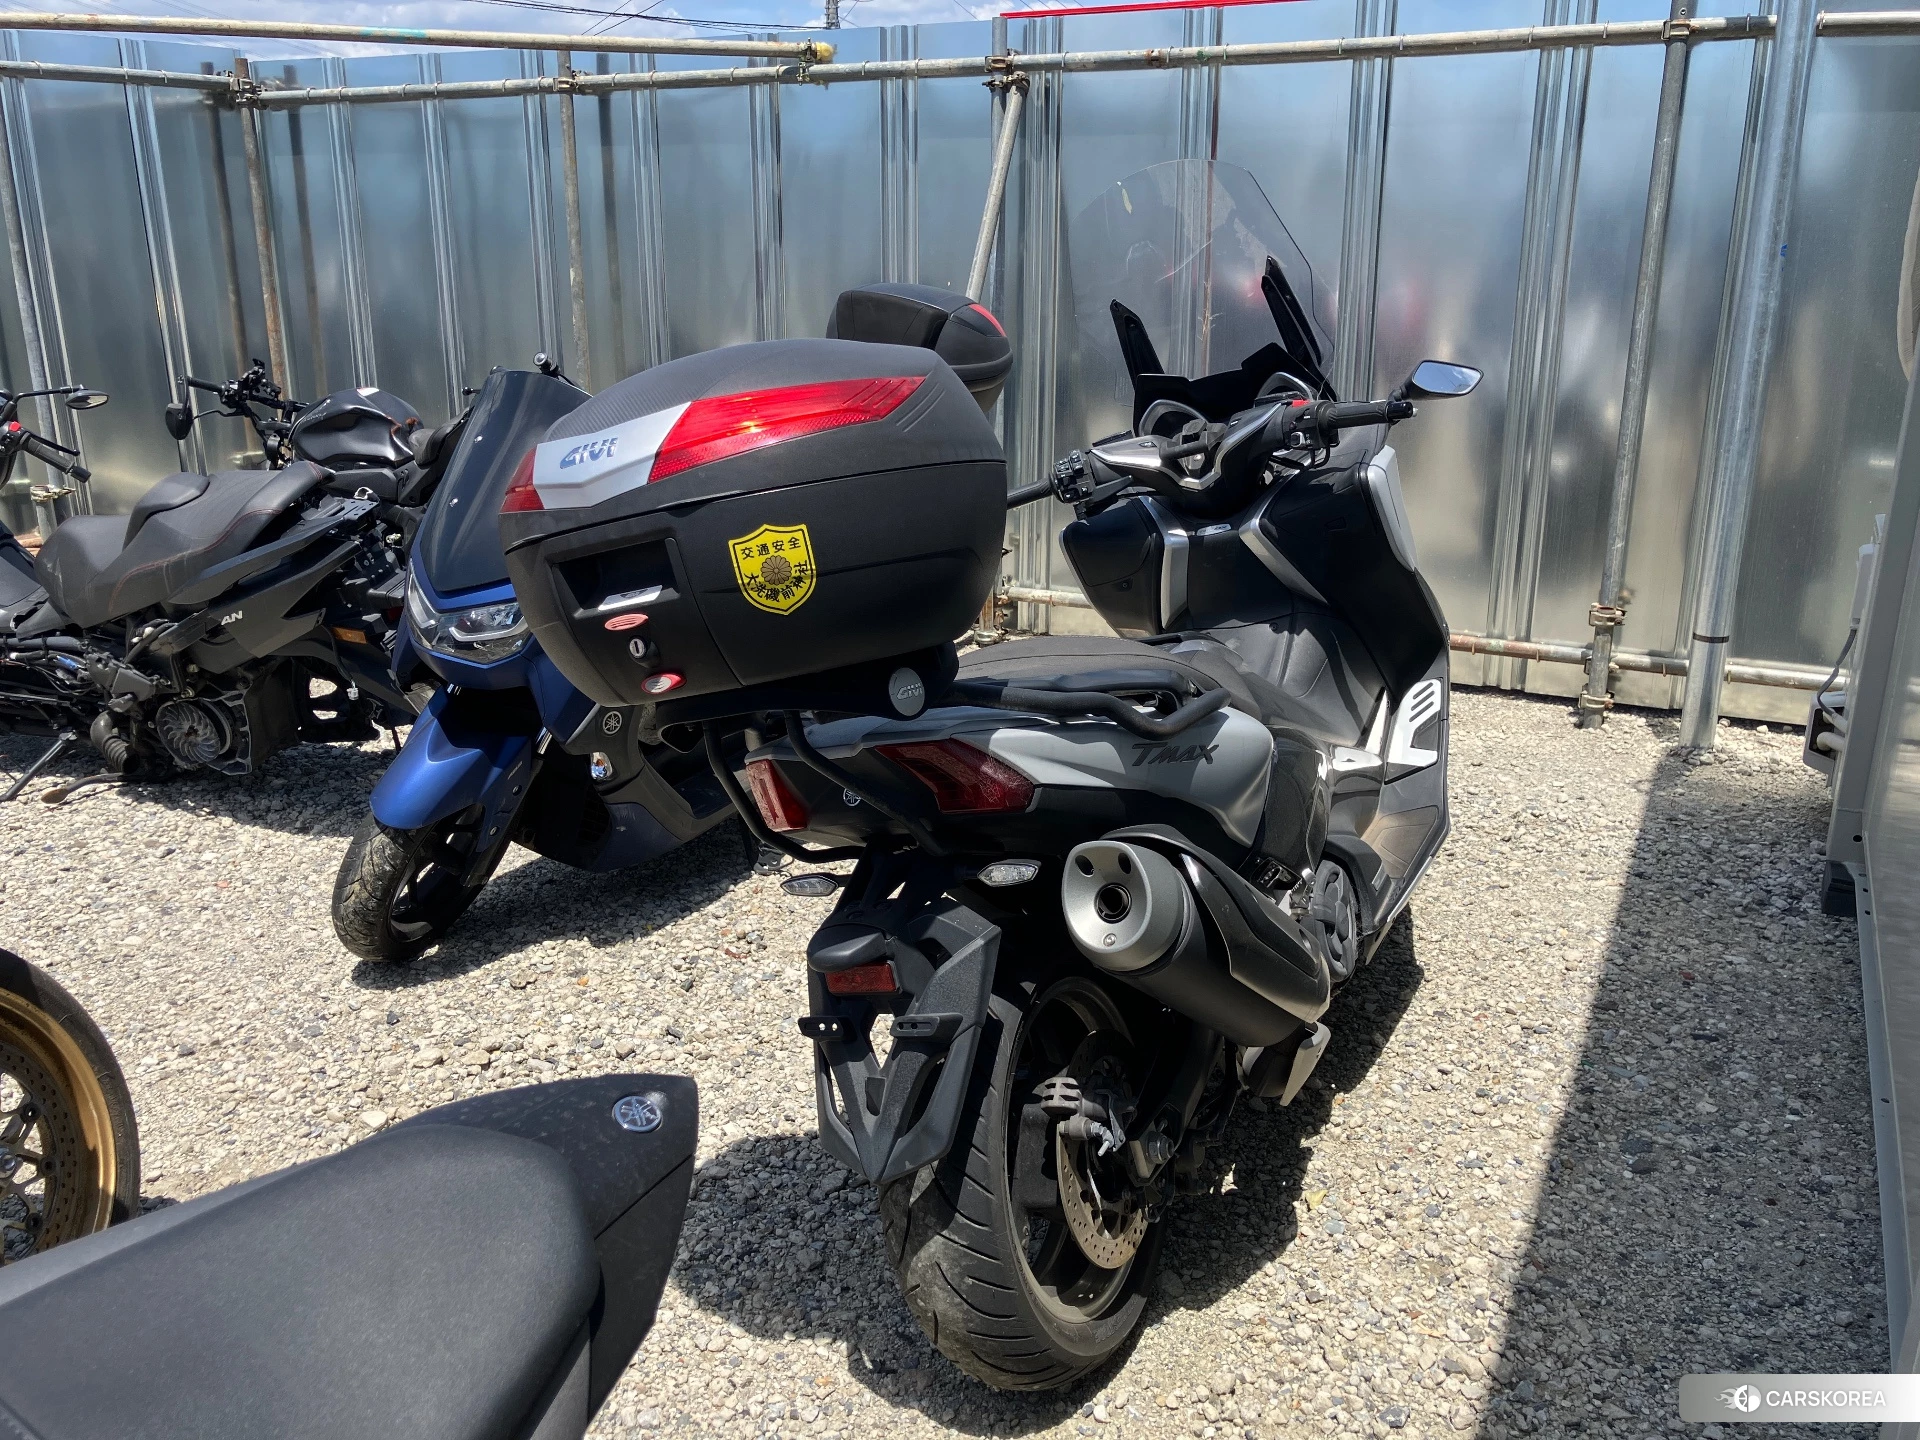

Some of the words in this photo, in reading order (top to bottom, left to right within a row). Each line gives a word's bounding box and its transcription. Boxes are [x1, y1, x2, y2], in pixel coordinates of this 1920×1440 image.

[560, 437, 618, 469] GIVI
[741, 536, 801, 560] 交通安全
[743, 560, 809, 602] 大洗磯前神社
[896, 683, 922, 700] GIVI
[1132, 742, 1219, 766] TMAX
